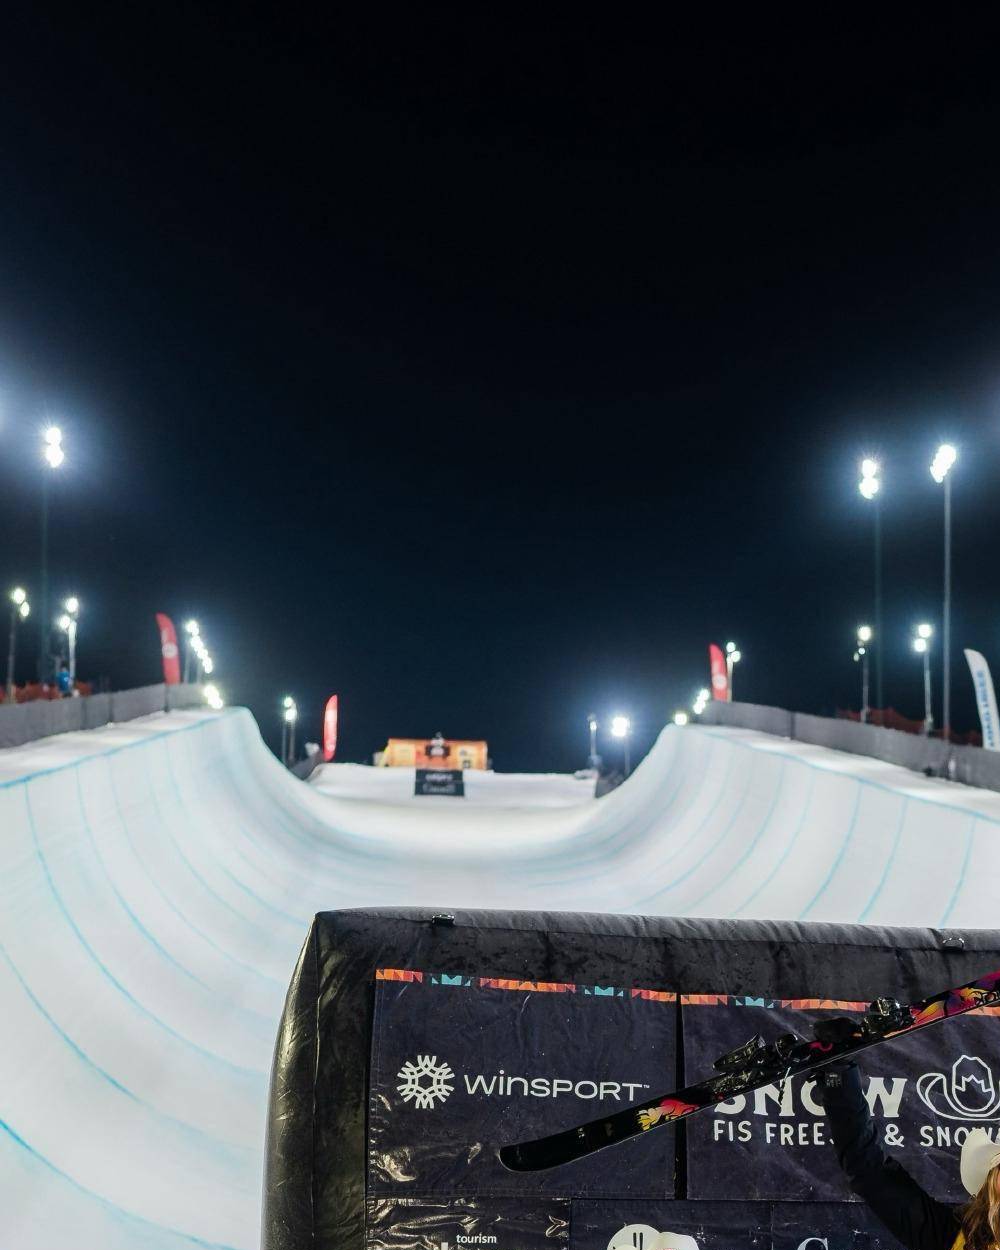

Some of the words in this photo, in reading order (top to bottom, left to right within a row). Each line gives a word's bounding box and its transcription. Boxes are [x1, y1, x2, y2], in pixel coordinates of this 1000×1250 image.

[714, 1119, 752, 1142] FIS
[765, 1122, 834, 1146] FREE
[885, 1123, 904, 1148] &
[456, 1233, 497, 1244] tourism
